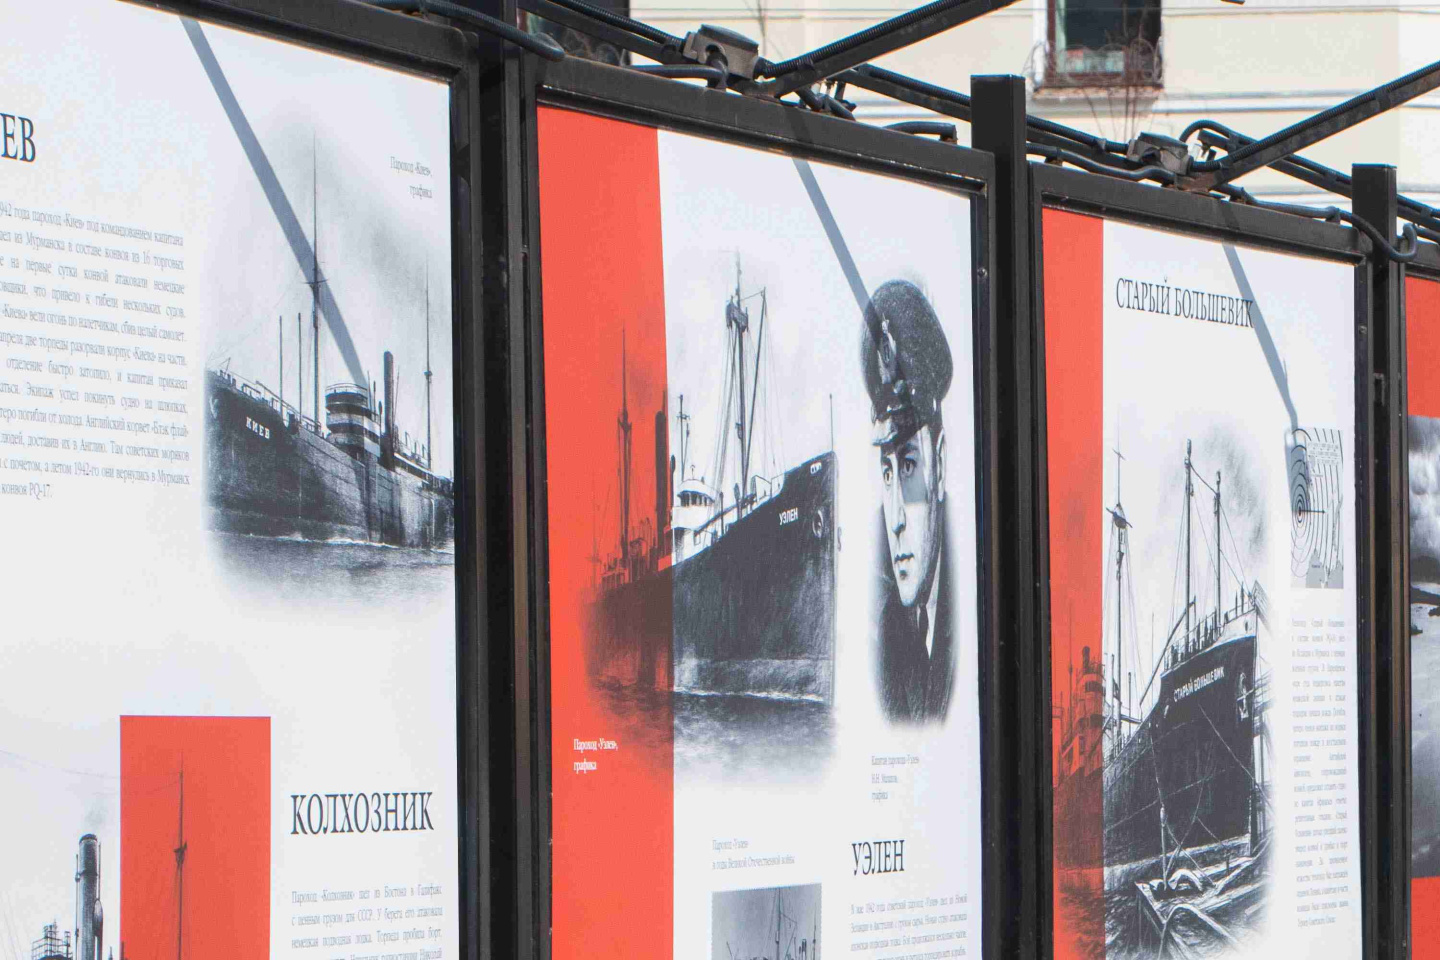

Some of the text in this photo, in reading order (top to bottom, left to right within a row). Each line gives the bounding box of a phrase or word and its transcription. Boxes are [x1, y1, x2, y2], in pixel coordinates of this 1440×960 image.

[1116, 276, 1254, 328] СТАРЫЙ БОЛЬШЕВИК
[779, 507, 799, 525] УЭЛЕН
[290, 792, 434, 835] КОЛХОЗНИК
[852, 840, 905, 876] УЭЛЕН
